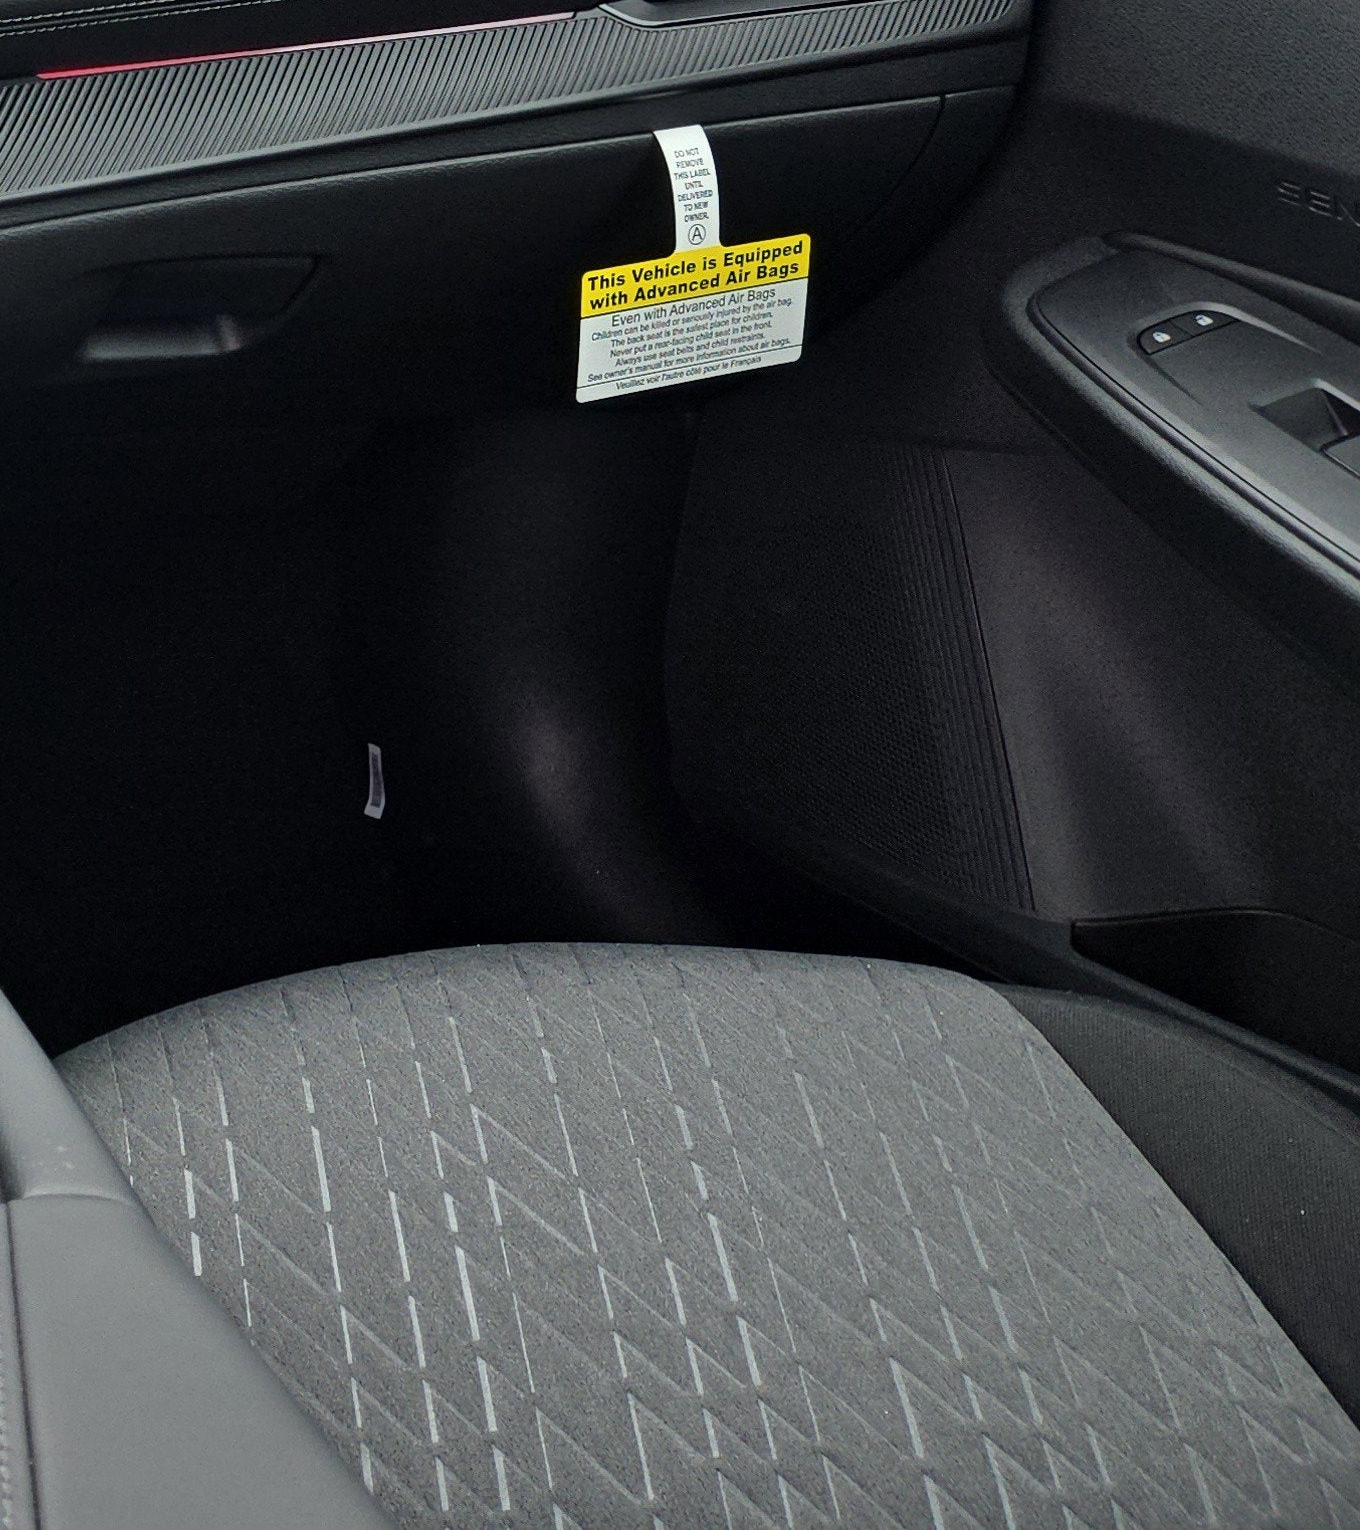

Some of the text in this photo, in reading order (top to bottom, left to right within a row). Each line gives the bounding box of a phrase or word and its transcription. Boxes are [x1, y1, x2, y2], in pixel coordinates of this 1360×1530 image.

[588, 240, 803, 291] This Vehicle is Equipped
[590, 262, 799, 310] with Advanced Air Bags
[591, 328, 623, 341] Children
[624, 325, 638, 335] can
[640, 323, 650, 332] be
[651, 318, 671, 330] killed
[682, 310, 715, 324] seriously
[716, 305, 741, 319] injured
[742, 304, 752, 314] by
[753, 301, 765, 311] the
[766, 299, 777, 308] air
[612, 288, 776, 327] Even with Advanced Air Bags
[610, 348, 632, 358] Never
[633, 344, 646, 356] put
[695, 330, 713, 342] child
[740, 324, 752, 333] the
[611, 338, 625, 347] The
[627, 334, 645, 345] back
[672, 326, 684, 336] the
[731, 316, 742, 325] for
[588, 373, 602, 383] See
[664, 358, 674, 368] for
[676, 356, 694, 365] more
[696, 347, 736, 361] information
[738, 341, 759, 353] about
[760, 339, 770, 348] air
[615, 354, 642, 367] Always
[696, 340, 710, 350] and
[711, 337, 728, 349] child
[615, 377, 645, 390] Veuillez
[646, 374, 660, 384] voir
[703, 363, 720, 374] pour
